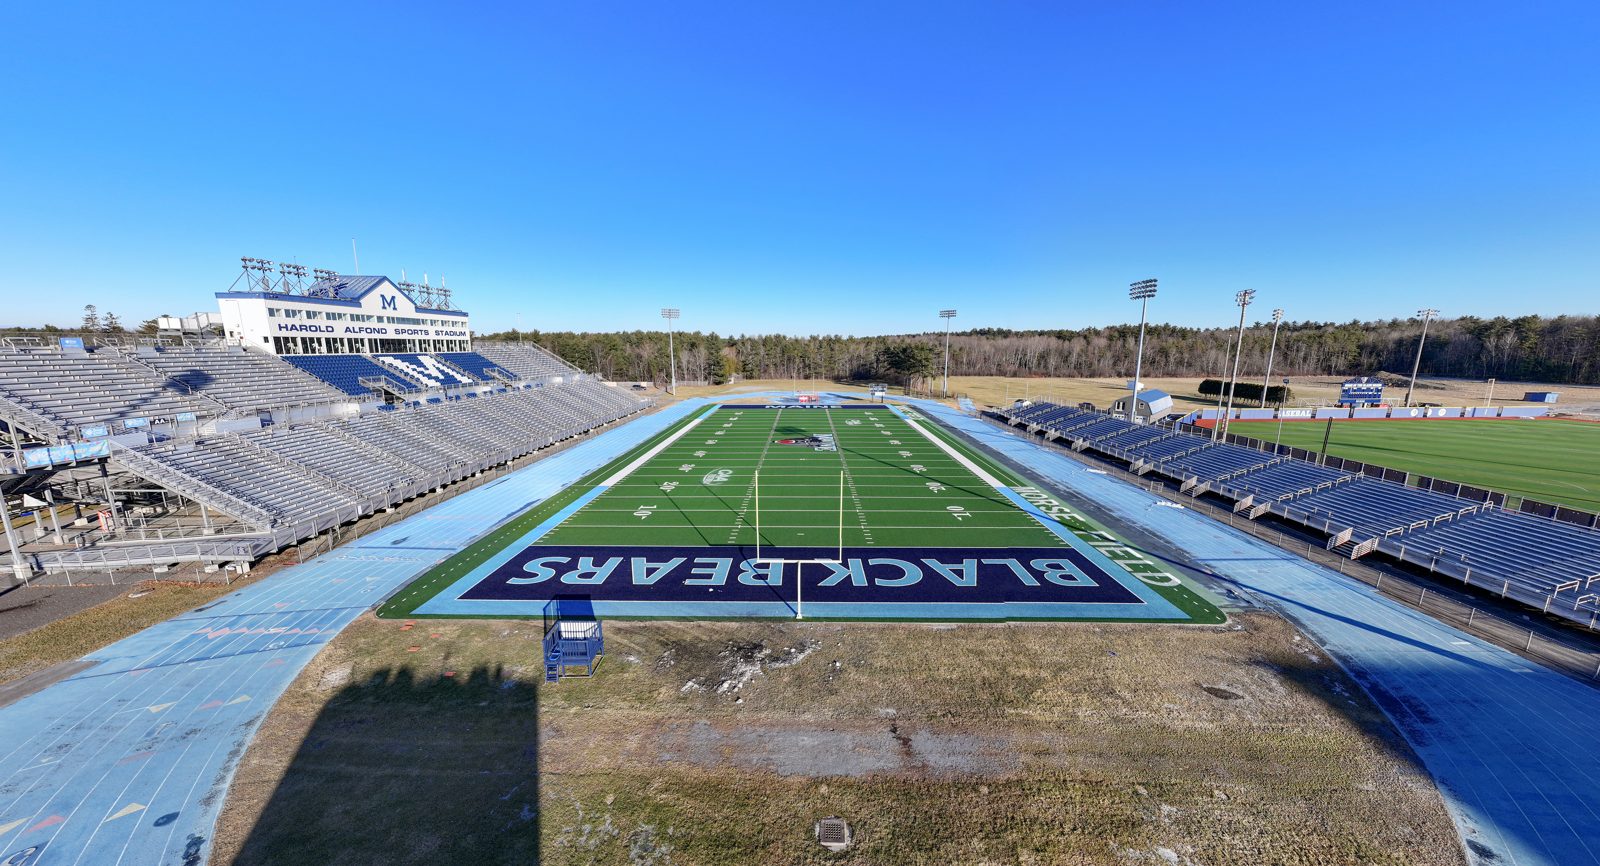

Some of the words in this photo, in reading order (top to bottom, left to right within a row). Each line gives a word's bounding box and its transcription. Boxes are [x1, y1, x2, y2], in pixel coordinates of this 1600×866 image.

[380, 294, 397, 311] M
[278, 323, 334, 332] HAROLD
[344, 326, 388, 335] ALFOND
[394, 328, 430, 336] SPORTS
[434, 329, 467, 337] STADIUM
[633, 505, 657, 519] 10
[946, 505, 972, 520] 10
[1072, 530, 1182, 587] FIELD
[506, 556, 784, 586] BEARS
[814, 558, 1100, 587] BLACK
